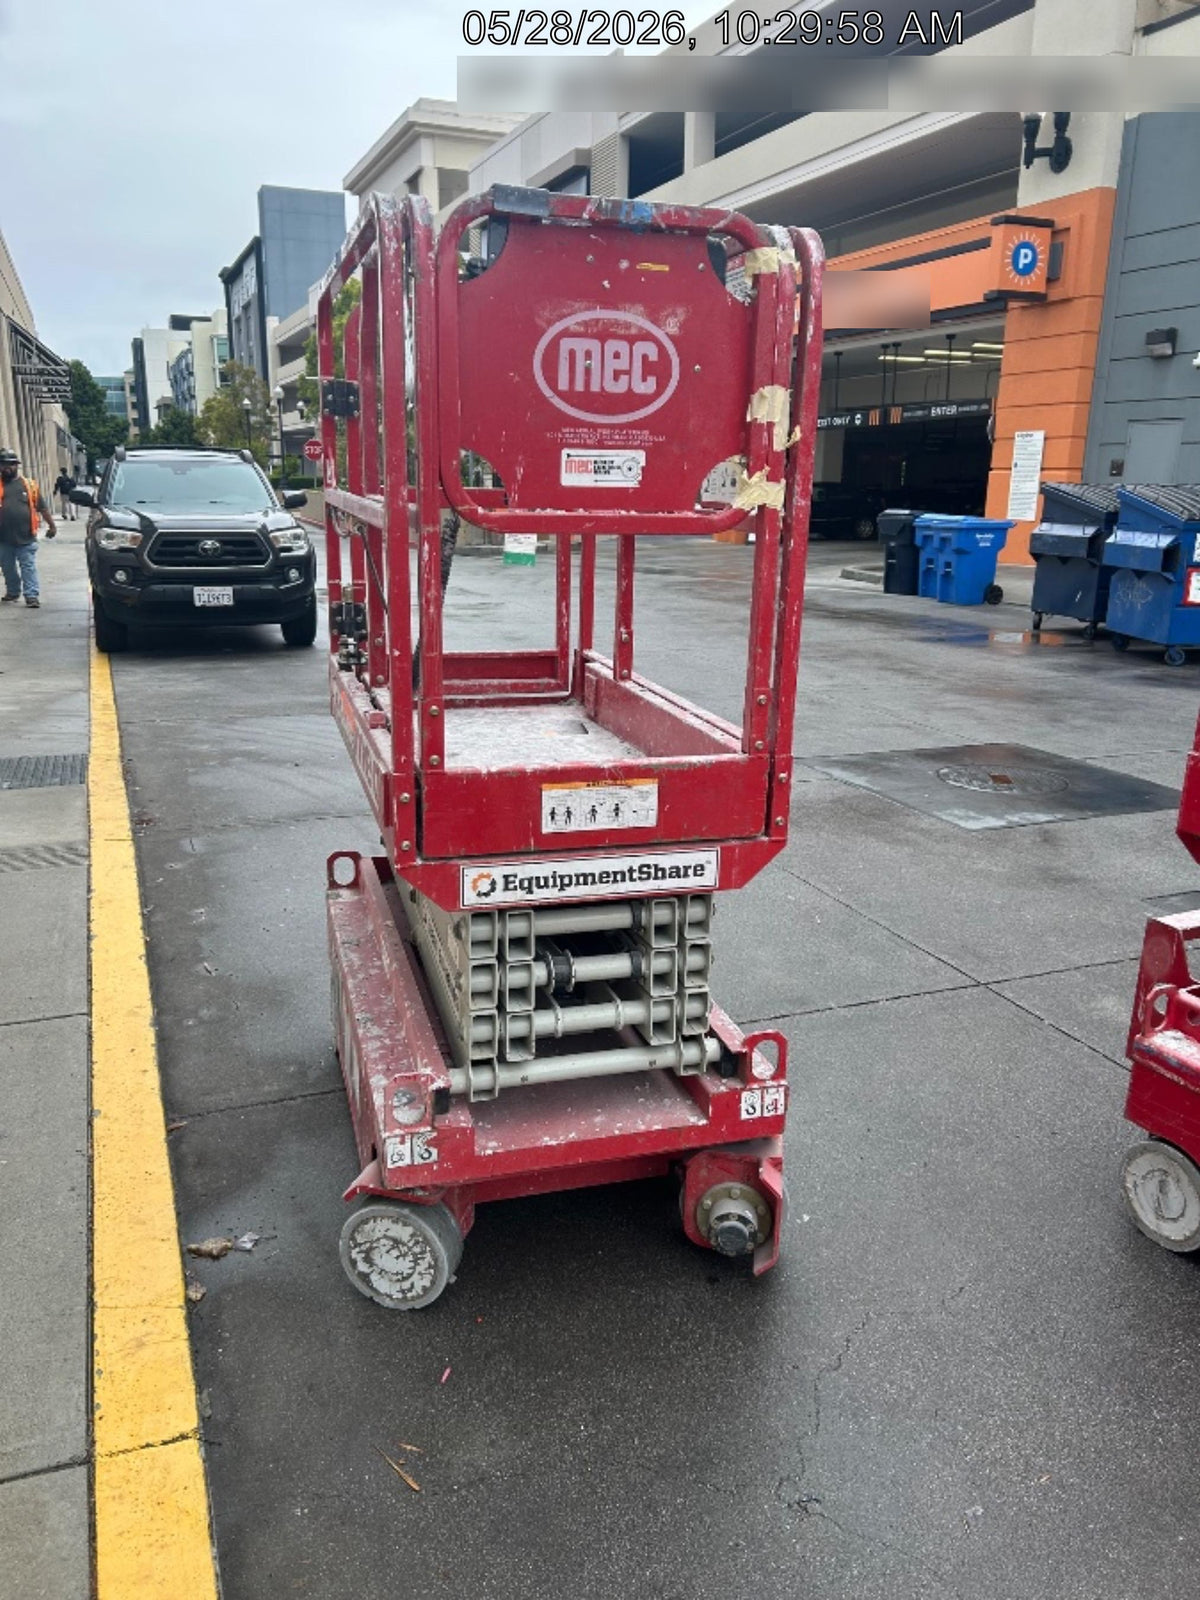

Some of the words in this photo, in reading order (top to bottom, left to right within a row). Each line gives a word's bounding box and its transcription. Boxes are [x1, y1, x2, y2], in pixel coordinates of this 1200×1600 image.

[1018, 248, 1033, 269] P
[930, 405, 958, 417] ENTER
[502, 862, 706, 895] EquipmentShare
